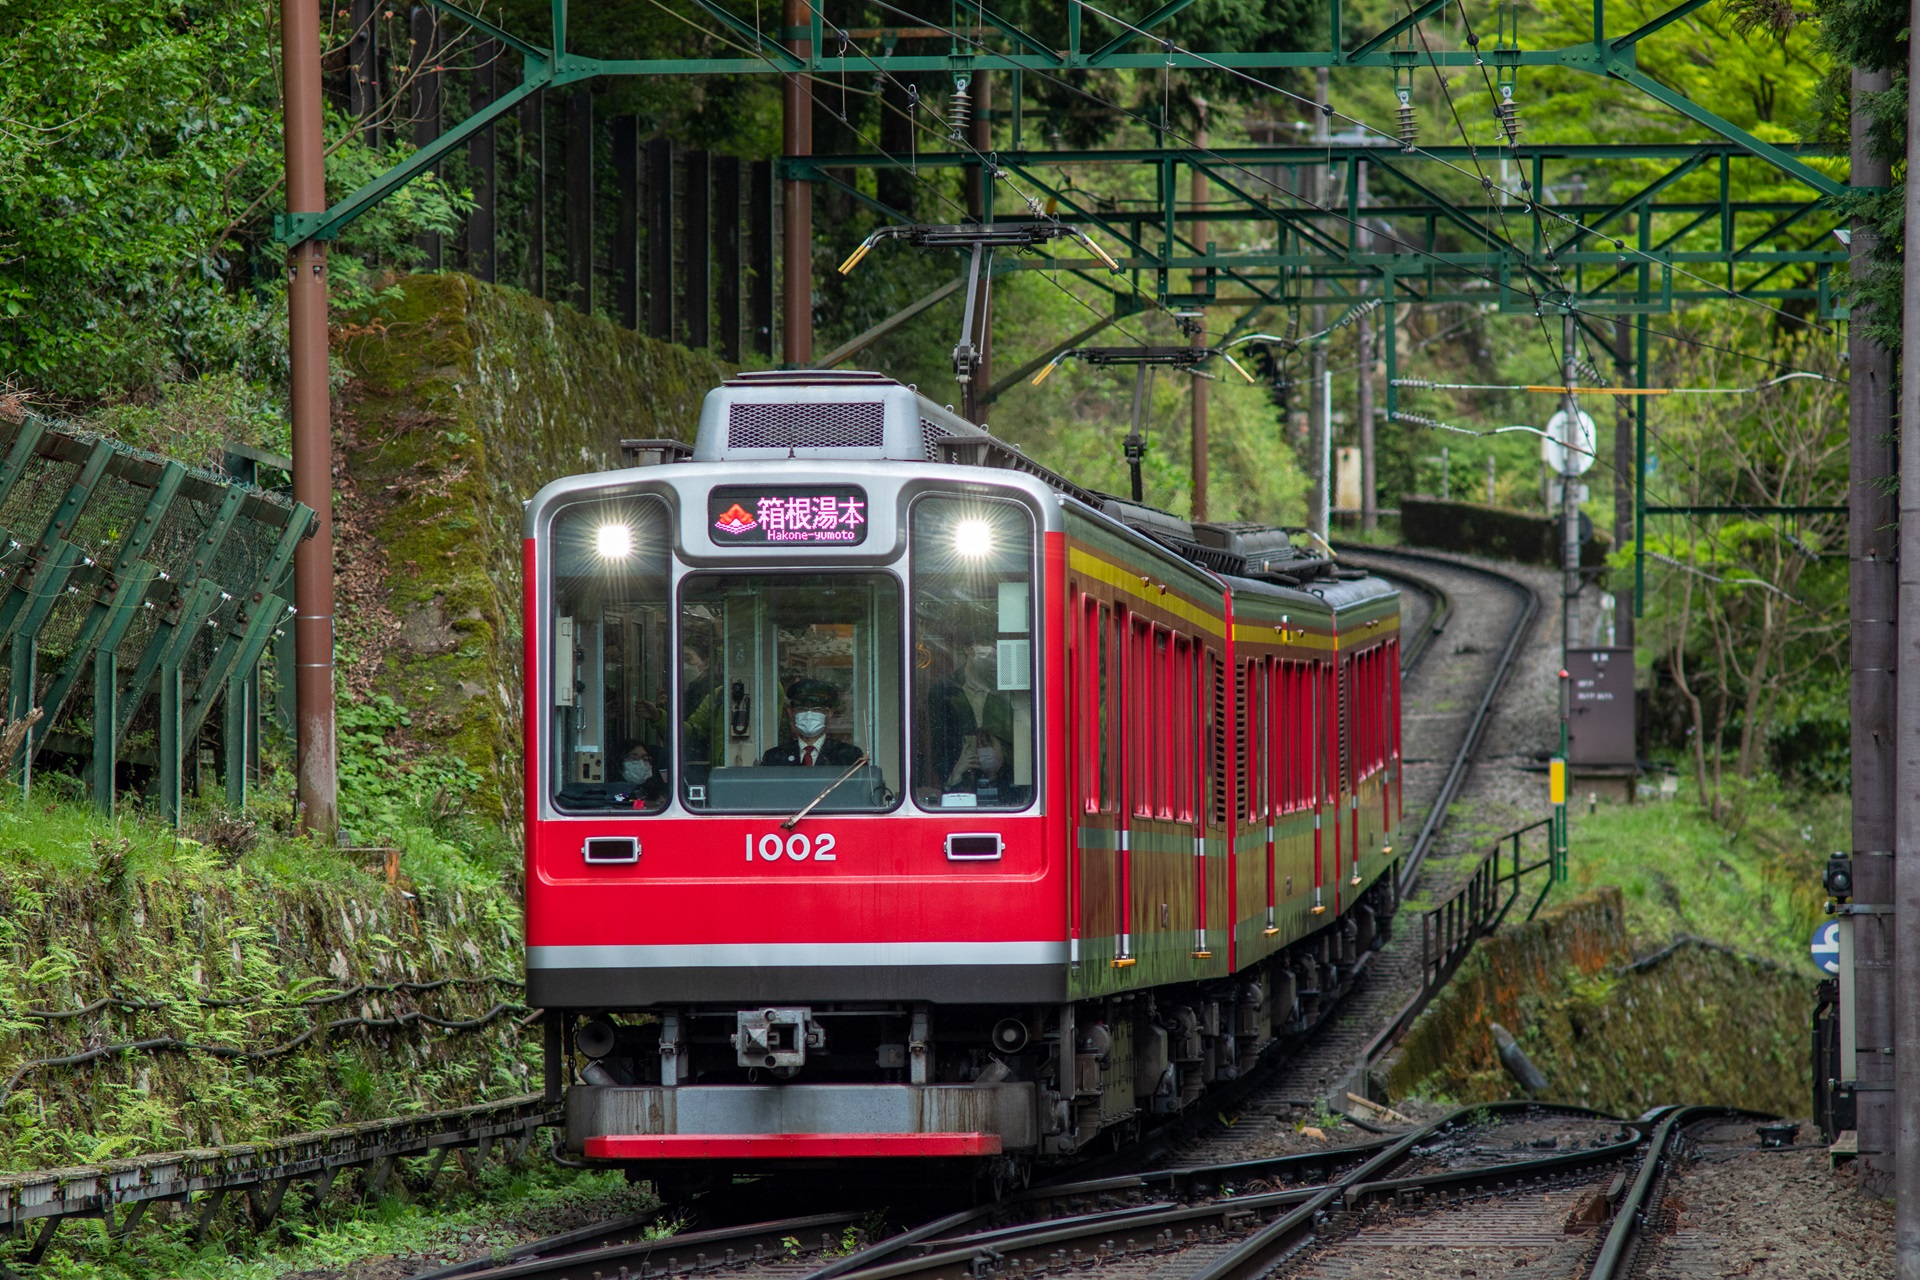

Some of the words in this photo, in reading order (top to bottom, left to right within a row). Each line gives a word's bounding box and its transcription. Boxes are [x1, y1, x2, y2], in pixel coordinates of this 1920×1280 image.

[757, 497, 865, 530] 箱根湯本
[767, 530, 855, 541] Hakone-yumoto
[745, 833, 837, 862] 1002
